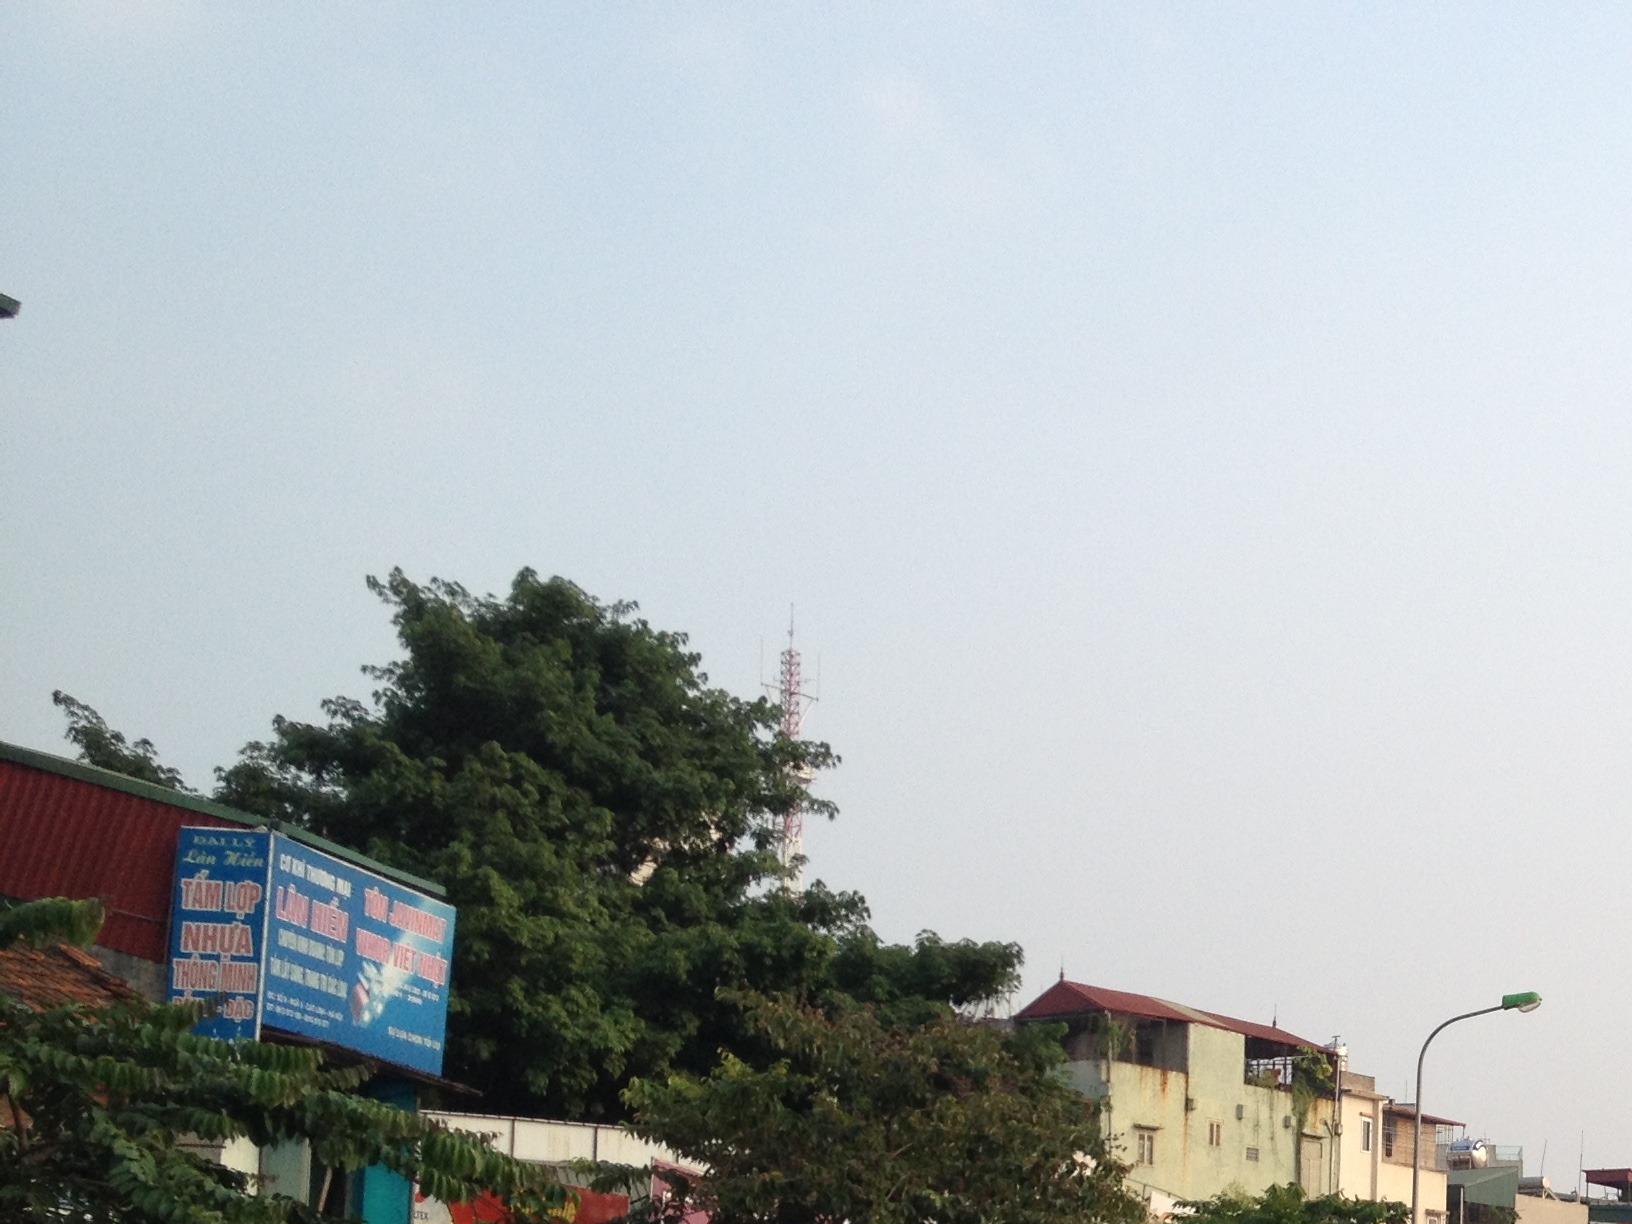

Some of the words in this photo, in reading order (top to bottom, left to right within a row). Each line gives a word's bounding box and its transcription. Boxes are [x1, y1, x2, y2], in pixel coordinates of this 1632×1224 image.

[180, 869, 223, 912] TẤM
[223, 880, 263, 920] LỢP
[180, 921, 254, 961] NHỰA
